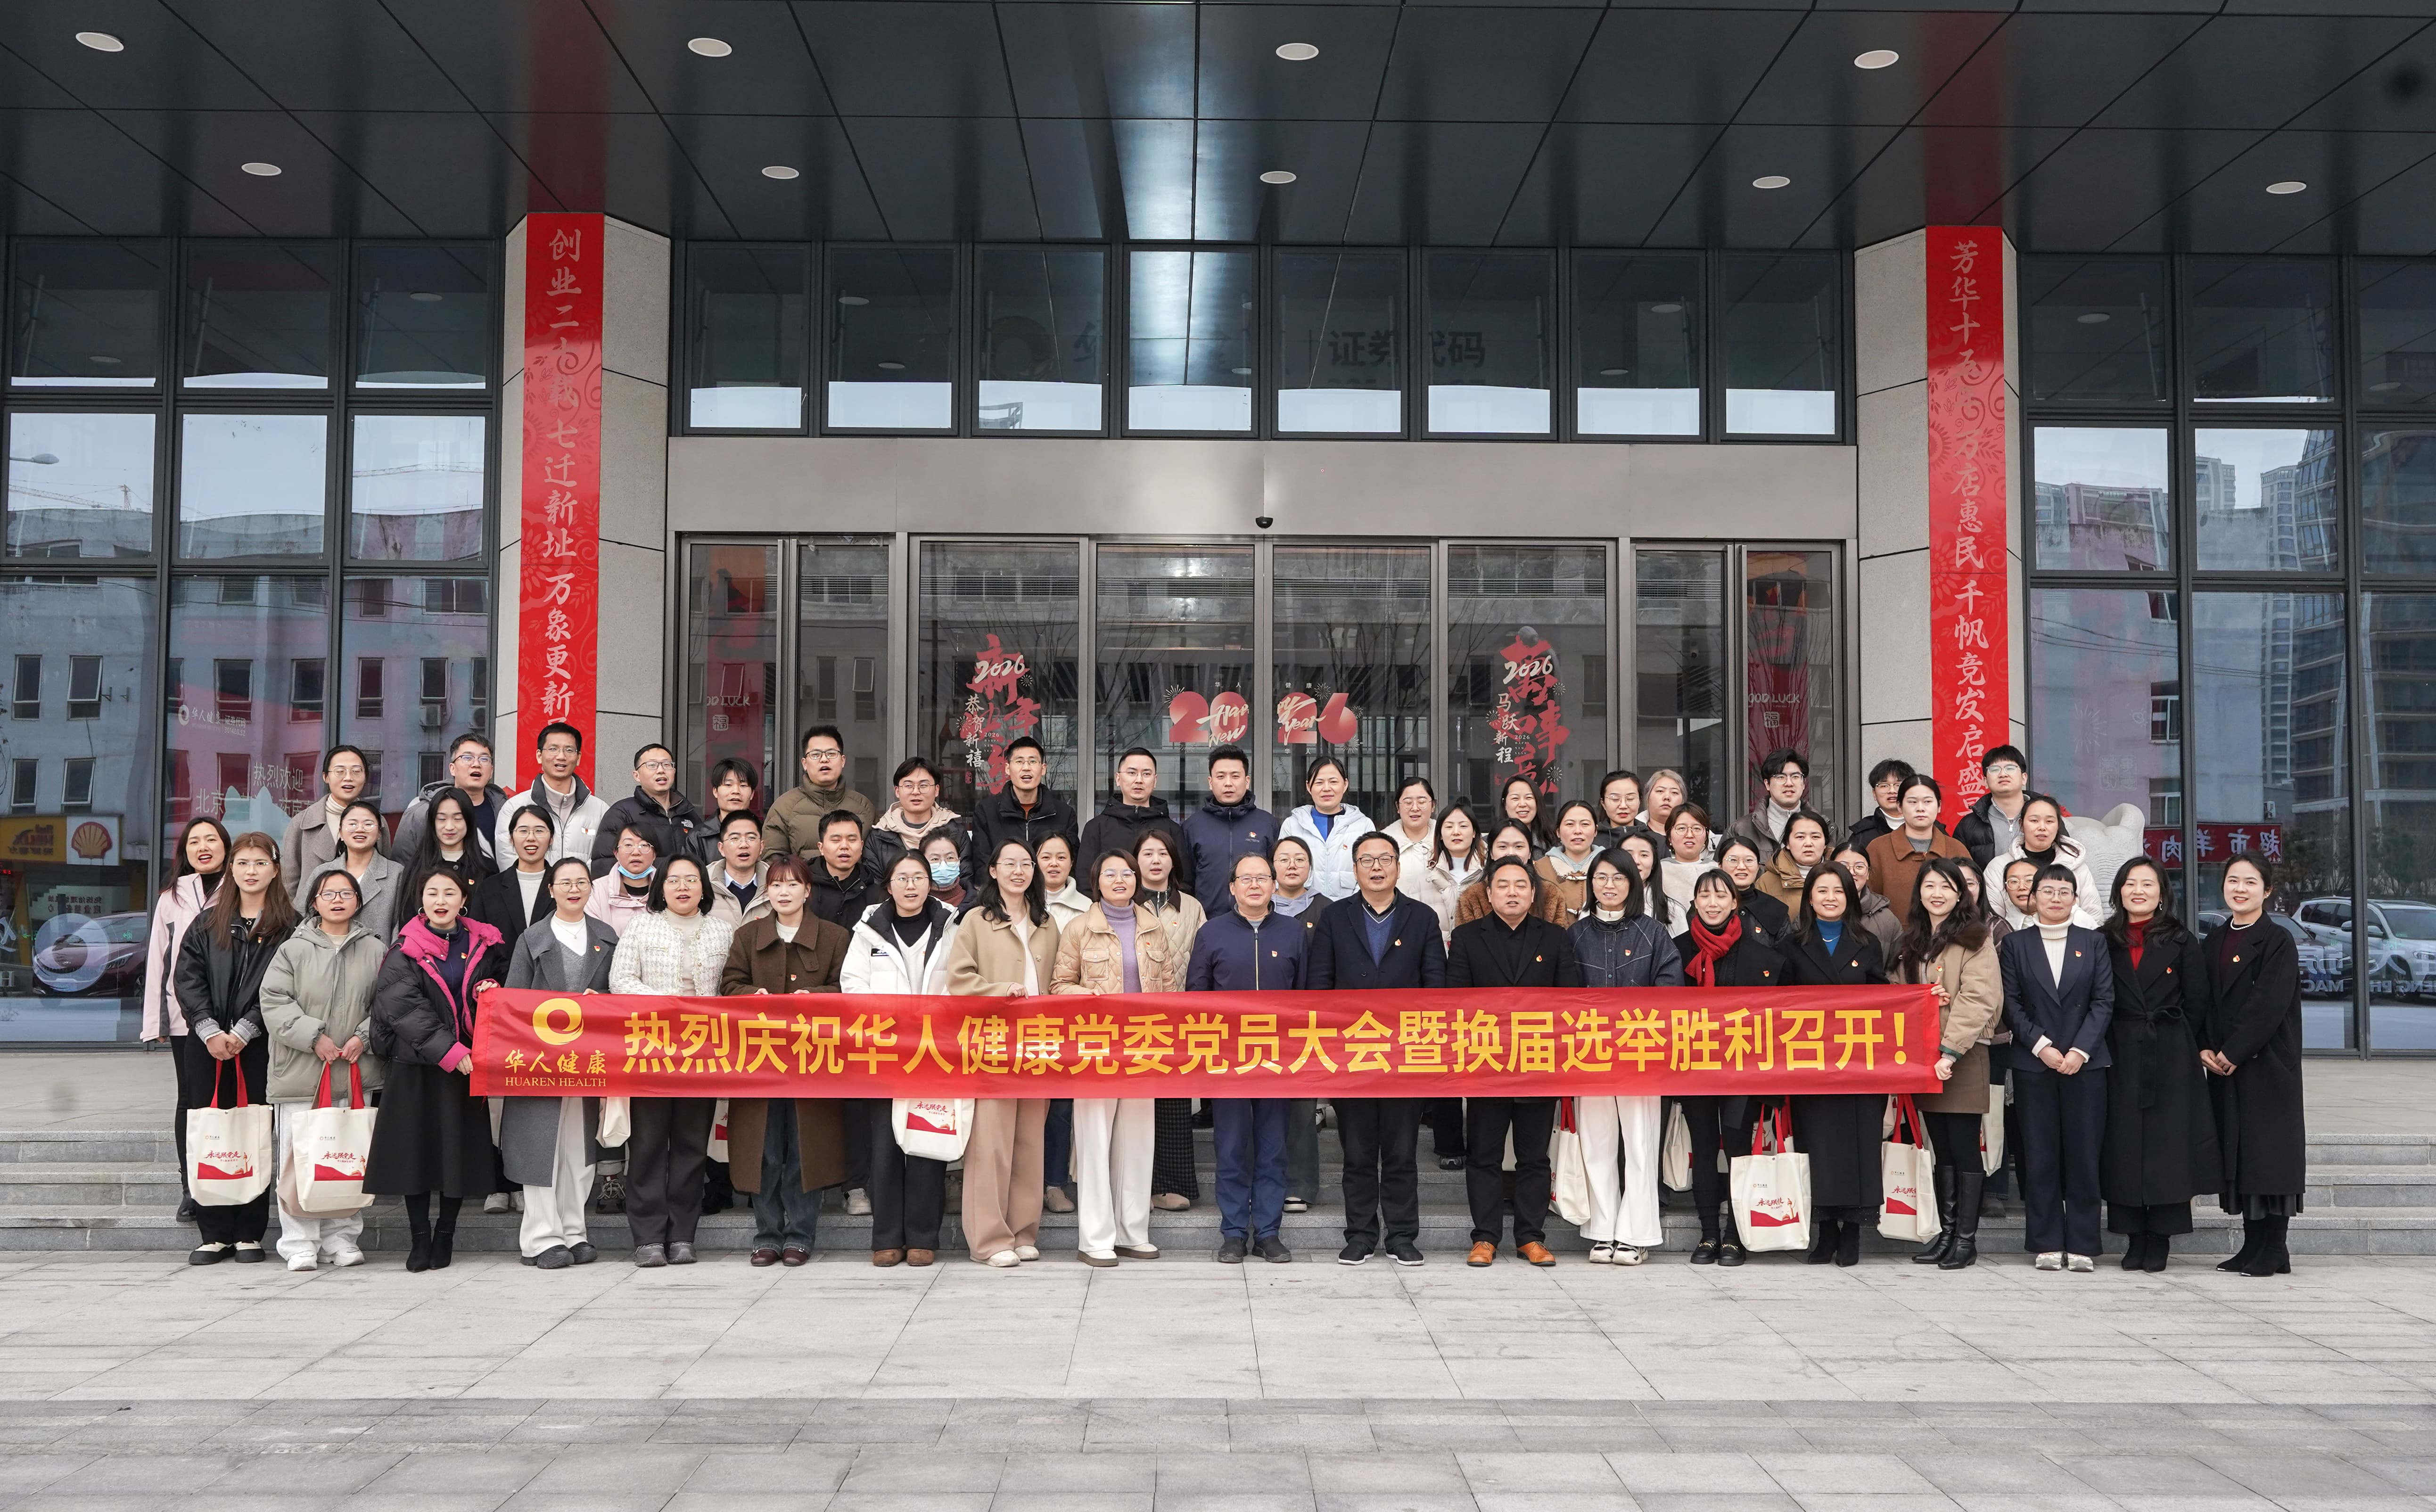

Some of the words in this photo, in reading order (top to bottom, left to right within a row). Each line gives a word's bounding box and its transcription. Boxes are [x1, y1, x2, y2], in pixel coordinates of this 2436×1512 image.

[540, 229, 581, 725] 创业二十载七迁新址万象更新
[975, 655, 1025, 683] 2026
[1503, 655, 1553, 684] 2026
[721, 695, 751, 707] LUCK
[1772, 693, 1801, 704] LUCK
[713, 715, 728, 730] 福
[963, 694, 985, 768] 恭贺新禧
[1493, 693, 1520, 764] 马跃新程
[1764, 712, 1779, 728] 福
[253, 761, 304, 792] 热烈欢迎
[505, 1049, 606, 1075] 华人健康
[505, 1077, 555, 1087] HUAREN
[559, 1077, 606, 1087] HEALTH
